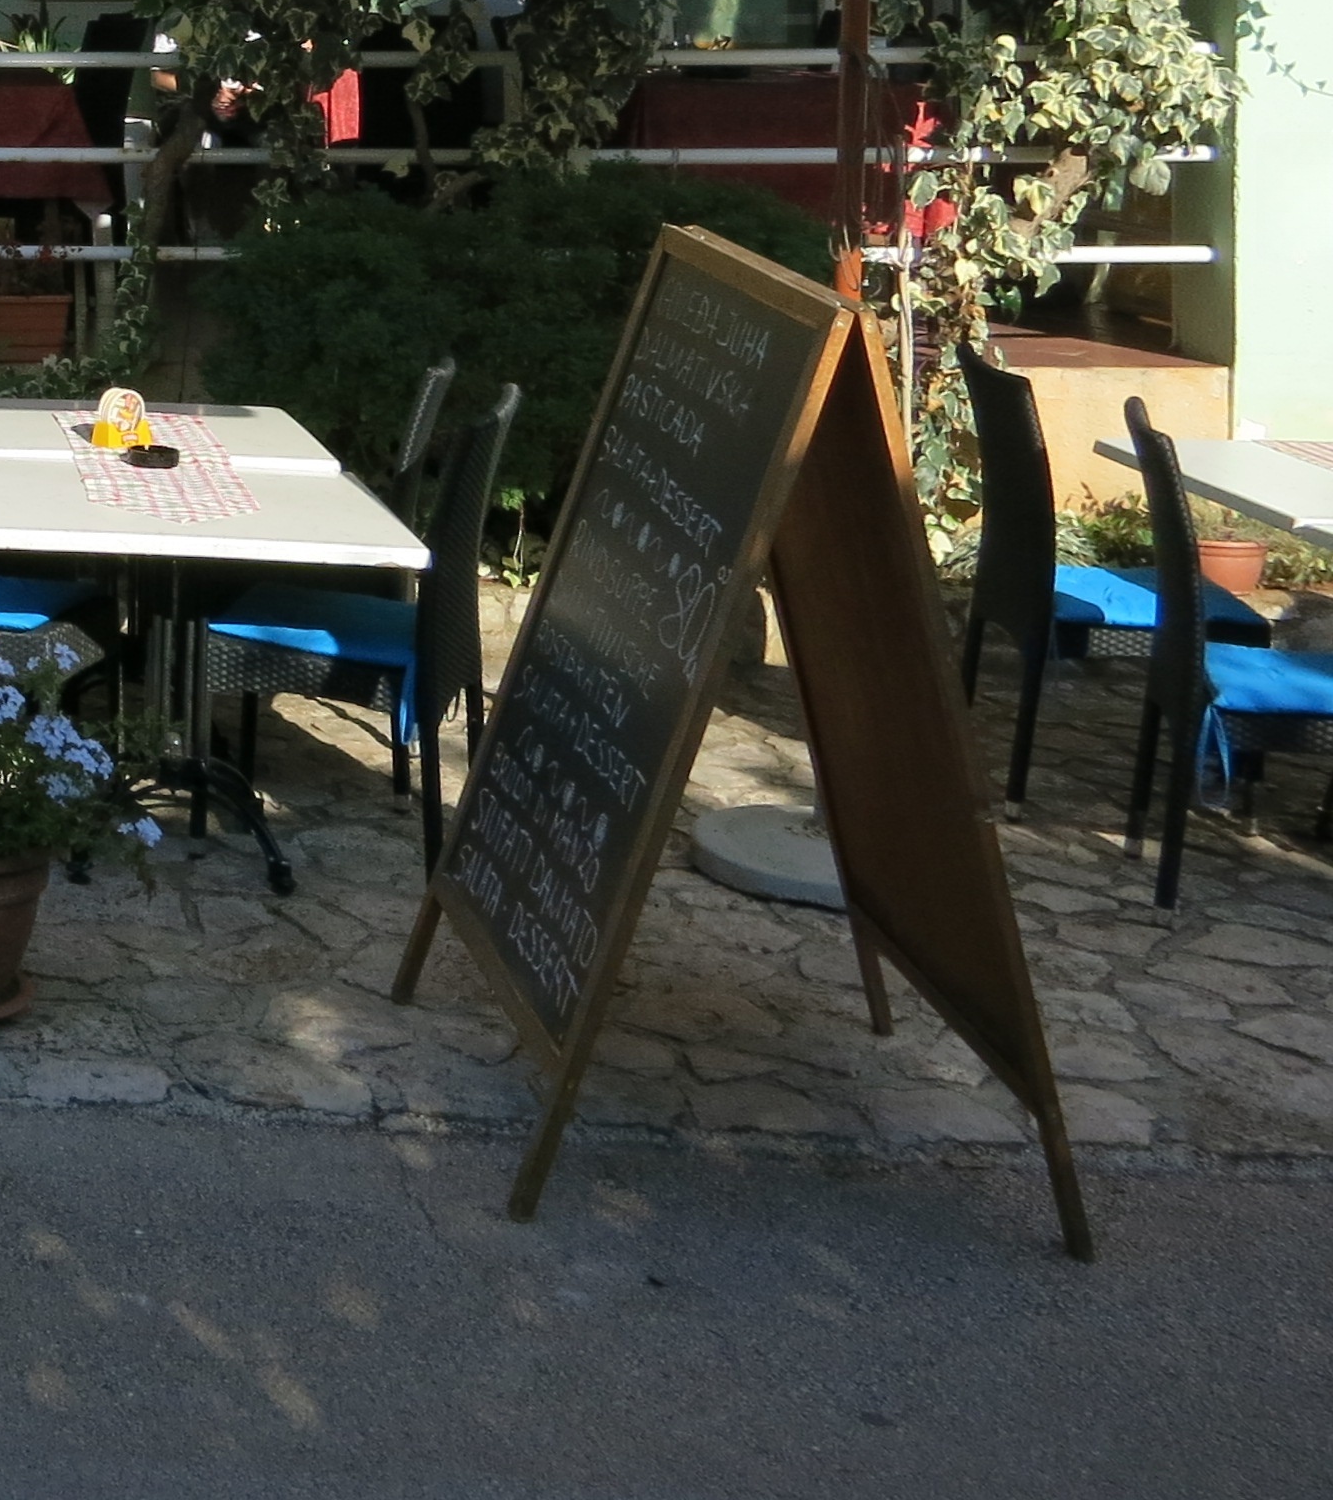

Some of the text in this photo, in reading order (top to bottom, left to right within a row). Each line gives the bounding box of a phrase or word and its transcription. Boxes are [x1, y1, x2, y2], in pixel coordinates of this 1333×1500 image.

[716, 312, 771, 368] JUHA
[569, 519, 660, 628] RINDSUPPE
[574, 714, 646, 812] DESSERT
[550, 813, 600, 891] MANZO
[453, 841, 502, 915] SALATA
[507, 902, 578, 1018] DESSERT
